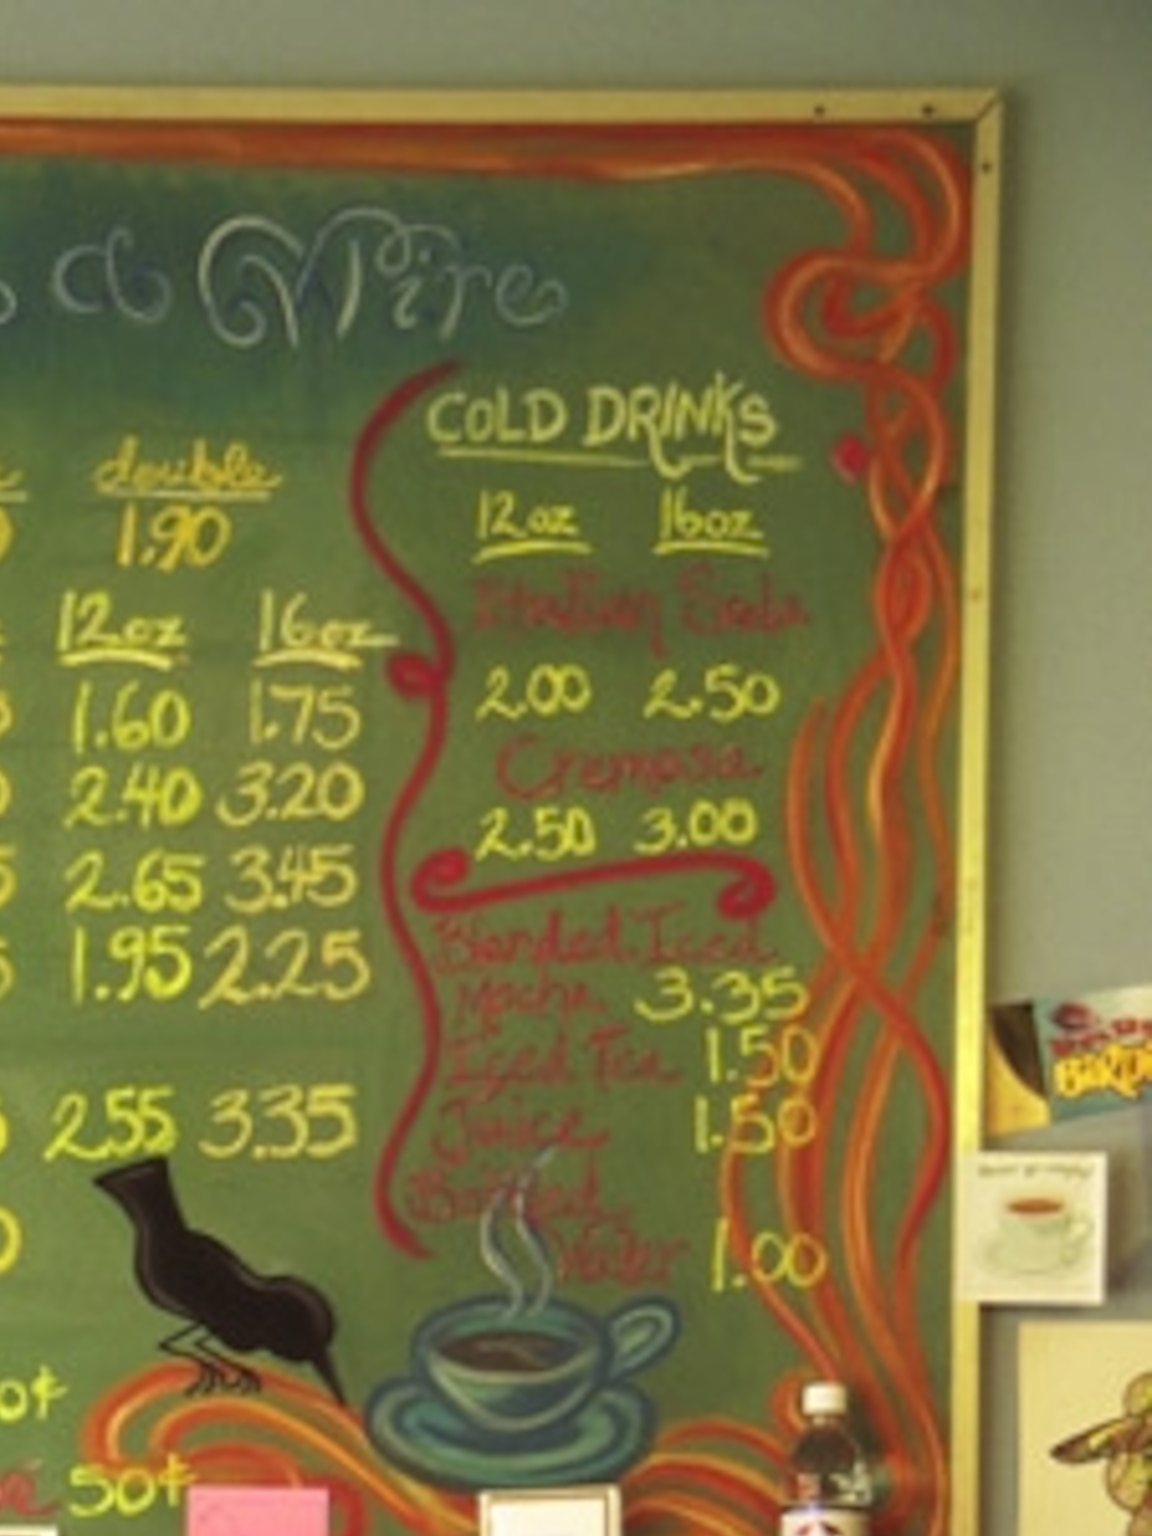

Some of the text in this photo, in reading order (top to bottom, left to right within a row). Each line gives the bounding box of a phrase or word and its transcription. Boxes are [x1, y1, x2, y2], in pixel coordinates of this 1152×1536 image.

[197, 206, 568, 350] Wire
[426, 371, 778, 484] COLD DRINKS
[91, 434, 285, 496] double
[117, 502, 232, 571] 1.90
[660, 486, 765, 541] 16oz
[257, 588, 401, 653] 16oz
[73, 679, 192, 755] 1.60
[250, 677, 363, 750] 1.75
[475, 662, 782, 722] 2.00 2.50
[63, 764, 203, 829] 2.40
[216, 761, 366, 828] 3.20
[475, 799, 759, 863] 2.50 3.00
[62, 850, 206, 913] 2.65
[224, 844, 356, 913] 3.45
[71, 925, 194, 1005] 1.95
[198, 926, 371, 1010] 2.25
[634, 964, 812, 1025] 3.35
[705, 1025, 821, 1089] 1.50
[198, 1083, 357, 1160] 3.35
[695, 1093, 819, 1154] 1.50
[711, 1216, 828, 1293] 1.00
